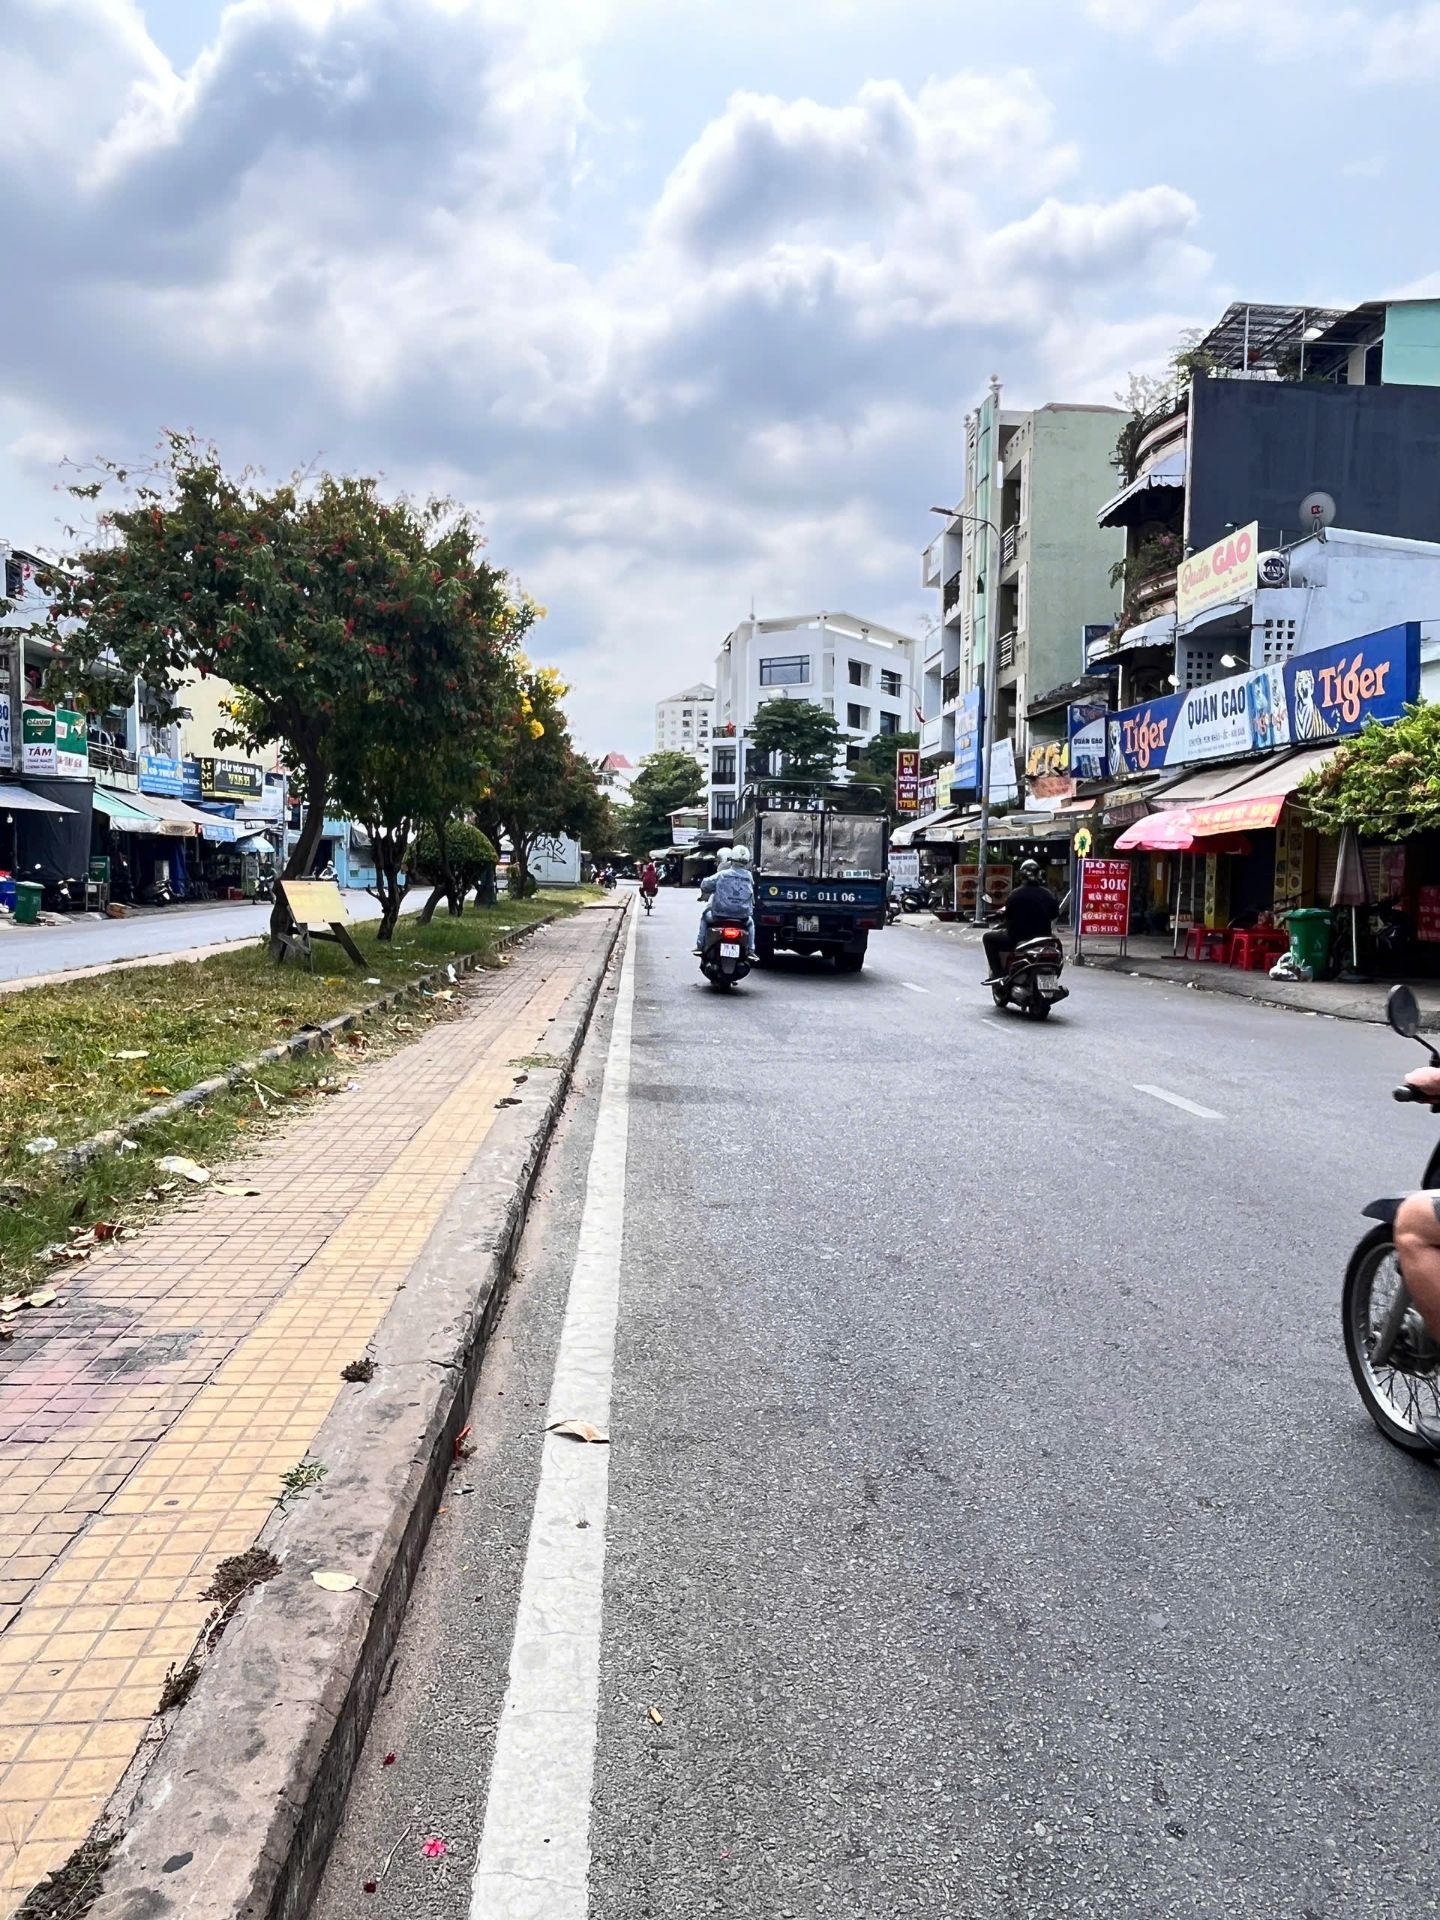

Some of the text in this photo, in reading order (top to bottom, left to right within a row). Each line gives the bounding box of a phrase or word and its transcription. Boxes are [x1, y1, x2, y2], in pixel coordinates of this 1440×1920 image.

[1212, 532, 1252, 576] GẠO
[1187, 685, 1246, 730] QUÁN GẠO
[1318, 652, 1390, 723] Tiger
[1122, 708, 1168, 769] Tiger
[786, 890, 808, 900] 51C
[1100, 878, 1127, 891] 30K
